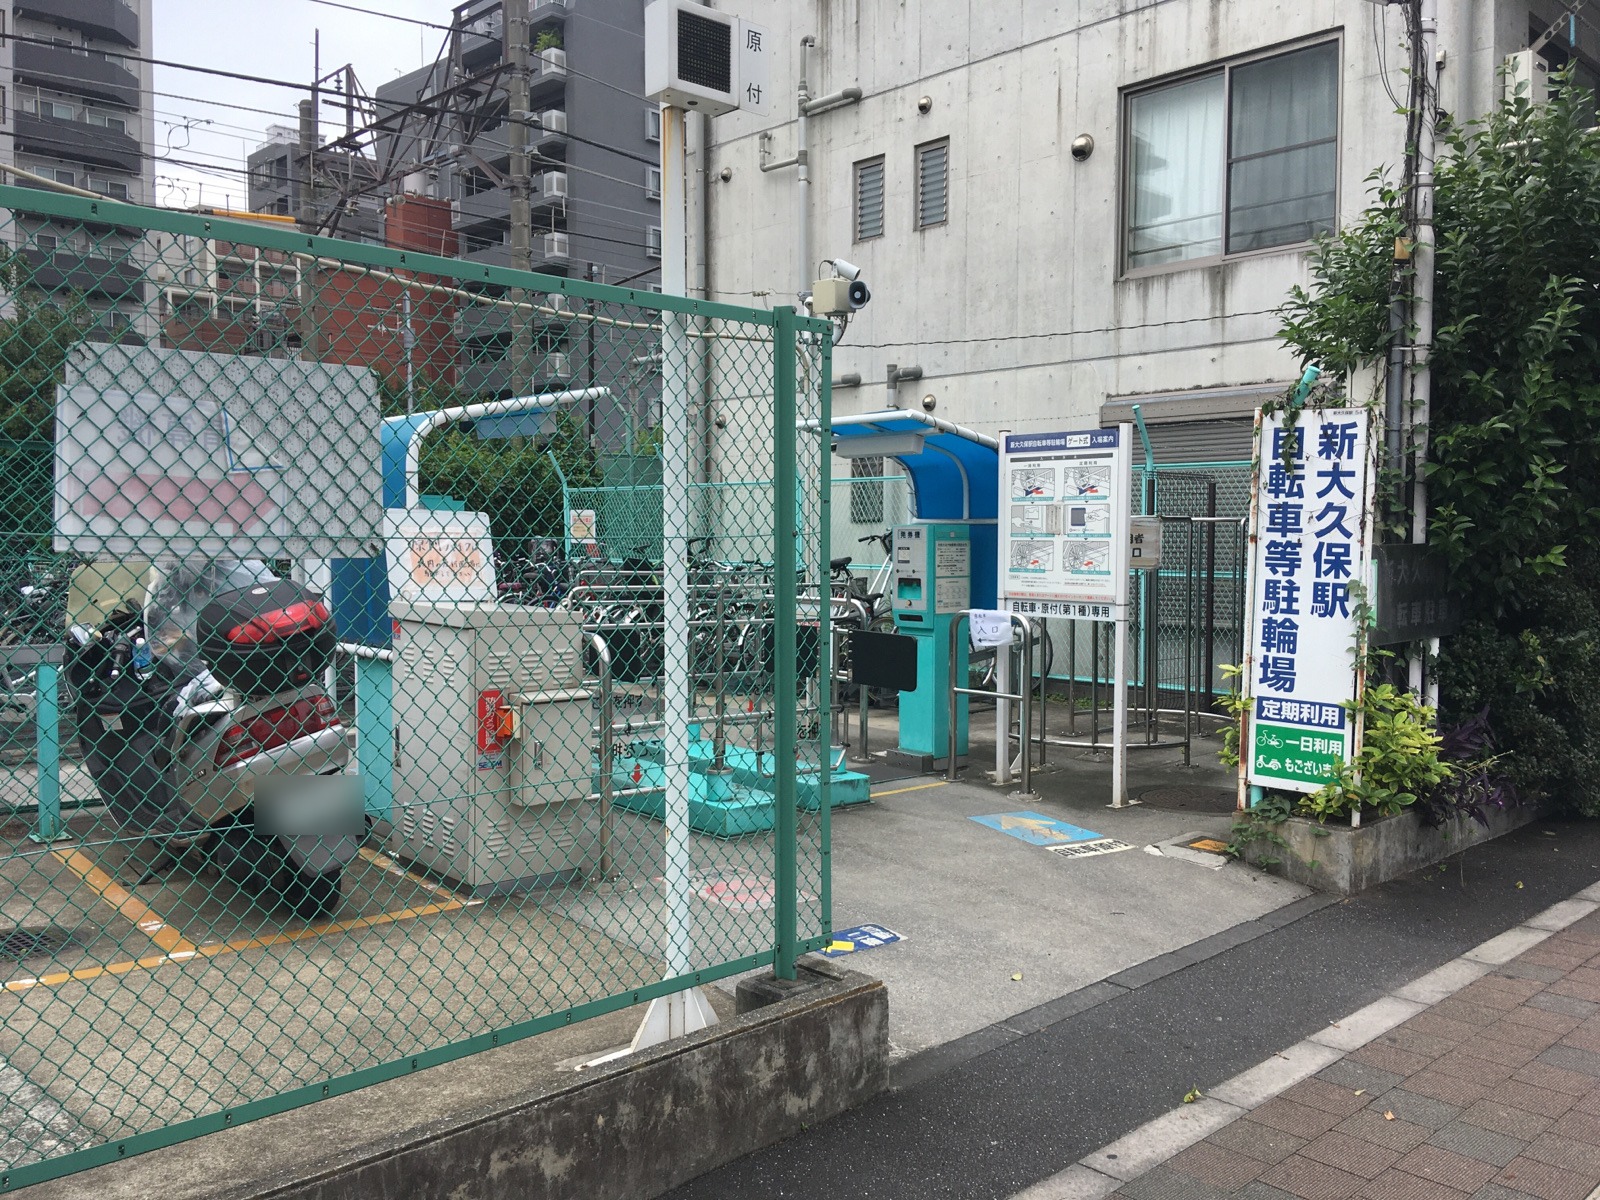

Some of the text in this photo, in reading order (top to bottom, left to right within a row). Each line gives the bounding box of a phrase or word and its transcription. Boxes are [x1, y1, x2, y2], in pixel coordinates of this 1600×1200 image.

[746, 29, 763, 105] 原付
[1067, 436, 1089, 446] ゲート式
[1091, 435, 1114, 444] 入場案内
[1310, 421, 1358, 619] 新大久保駅
[900, 530, 921, 539] 発券機
[1259, 426, 1306, 693] 自転車等駐輪場
[1261, 699, 1340, 727] 定期利用
[1285, 736, 1343, 757] 一日利用
[1285, 758, 1337, 778] もございま
